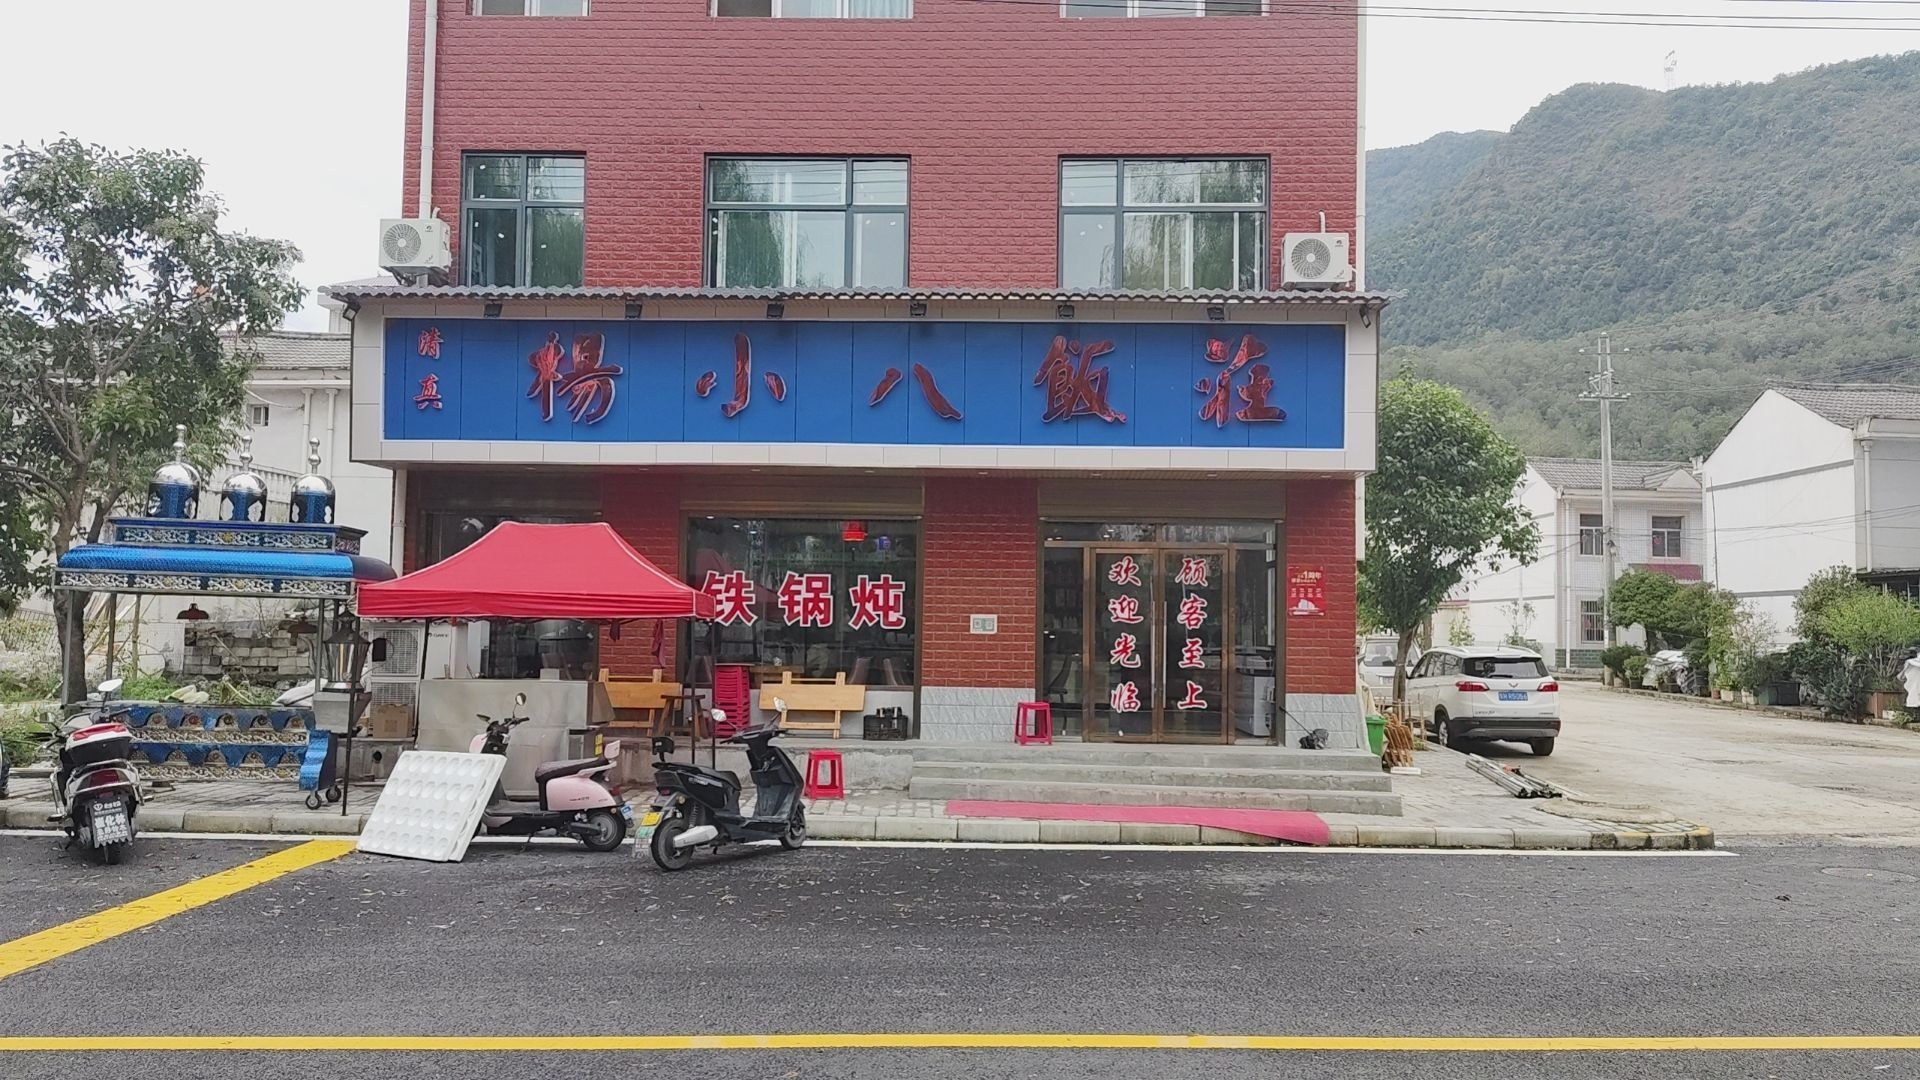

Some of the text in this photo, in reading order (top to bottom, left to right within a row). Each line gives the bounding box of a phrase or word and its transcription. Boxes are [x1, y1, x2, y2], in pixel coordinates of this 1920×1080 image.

[413, 327, 444, 410] 清真
[702, 571, 906, 630] 铁锅炖
[1108, 556, 1144, 713] 欢迎光临
[1175, 558, 1208, 709] 顾客至上
